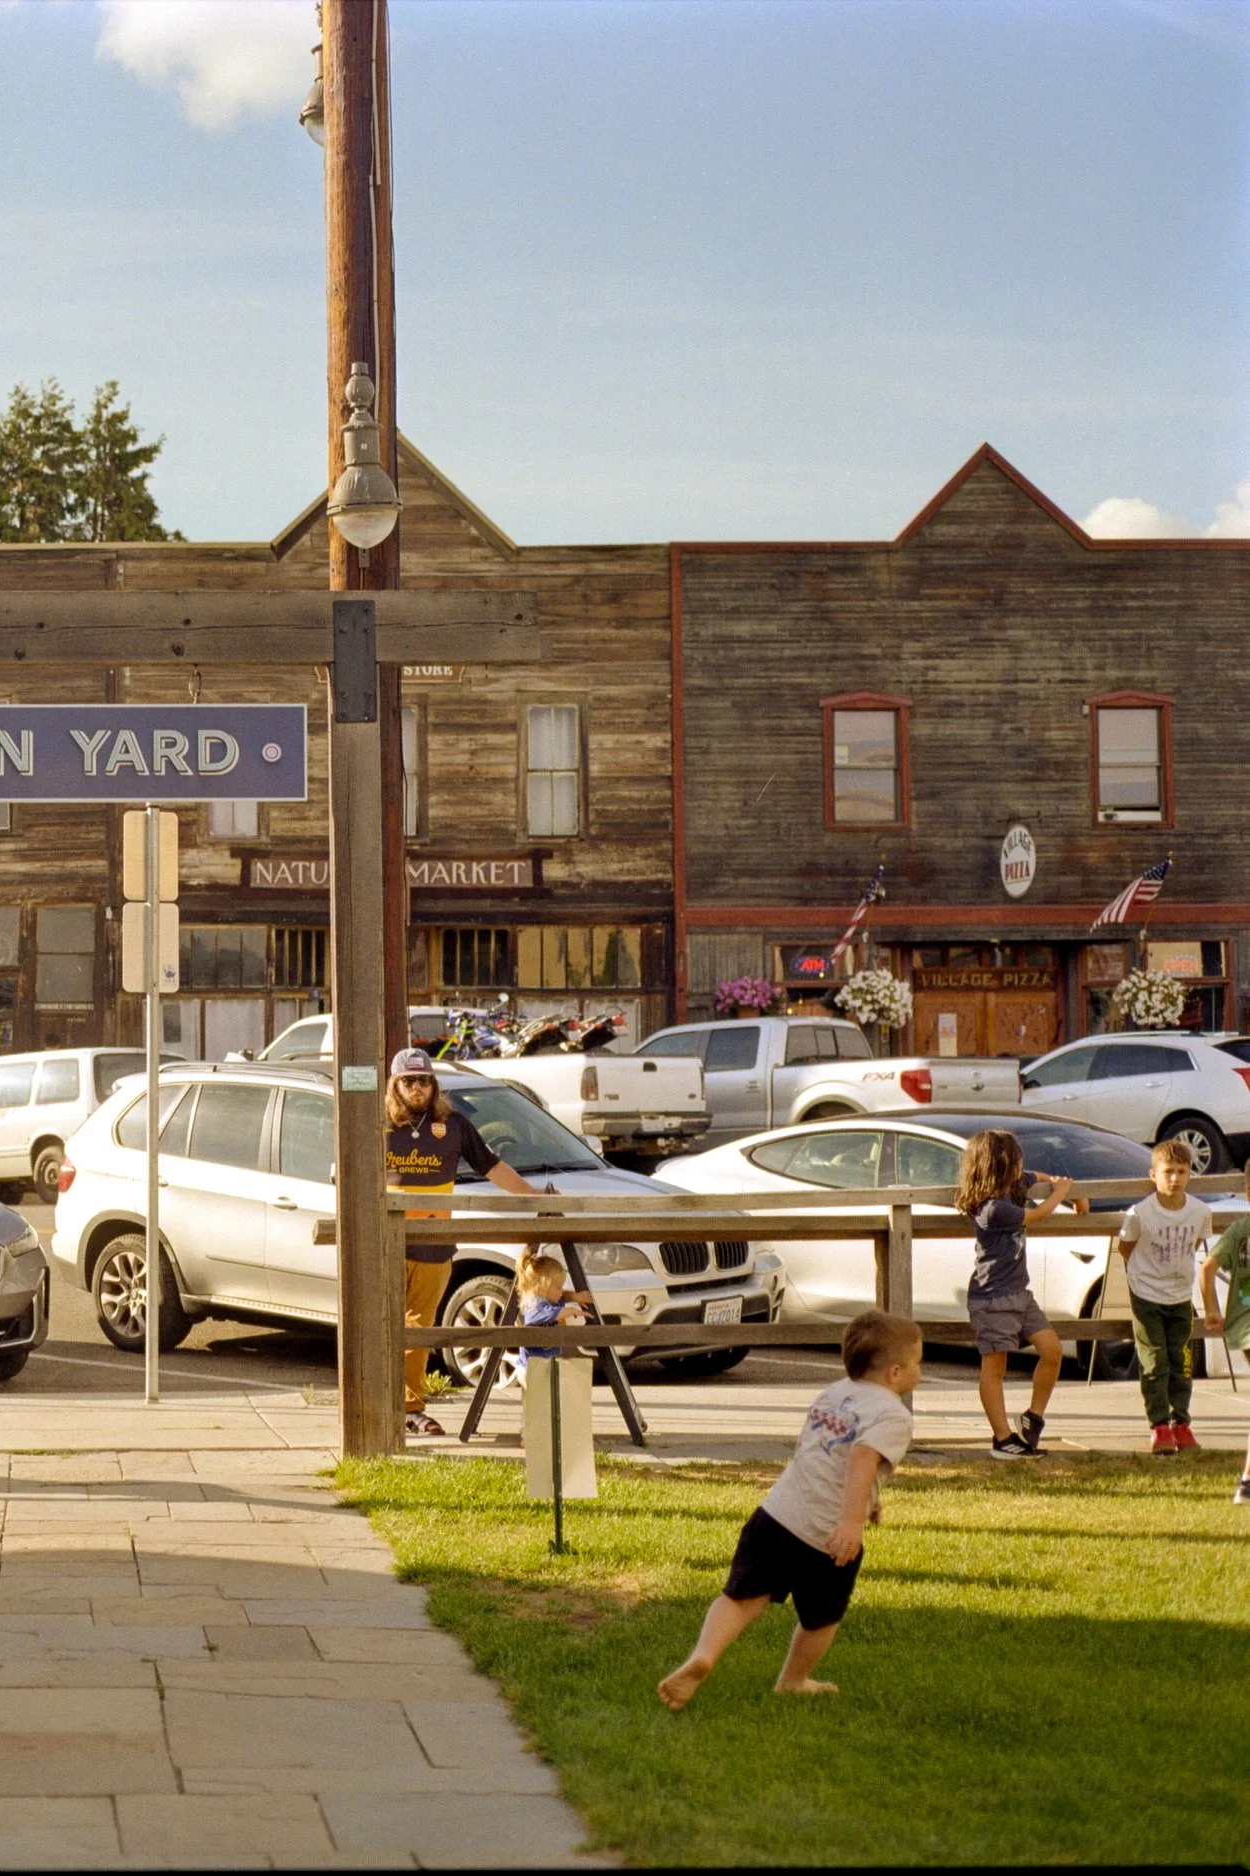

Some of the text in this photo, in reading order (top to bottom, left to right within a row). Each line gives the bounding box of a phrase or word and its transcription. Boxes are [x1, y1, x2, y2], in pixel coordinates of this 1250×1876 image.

[403, 665, 453, 676] STORE
[70, 729, 240, 777] YARD
[1003, 829, 1032, 859] VILLAGE
[255, 861, 526, 885] NATU MARKET
[1004, 860, 1030, 881] PIZZA
[921, 971, 1053, 987] VILLAGE PIZZA
[861, 1071, 896, 1082] FX4
[398, 1166, 429, 1174] BREWS
